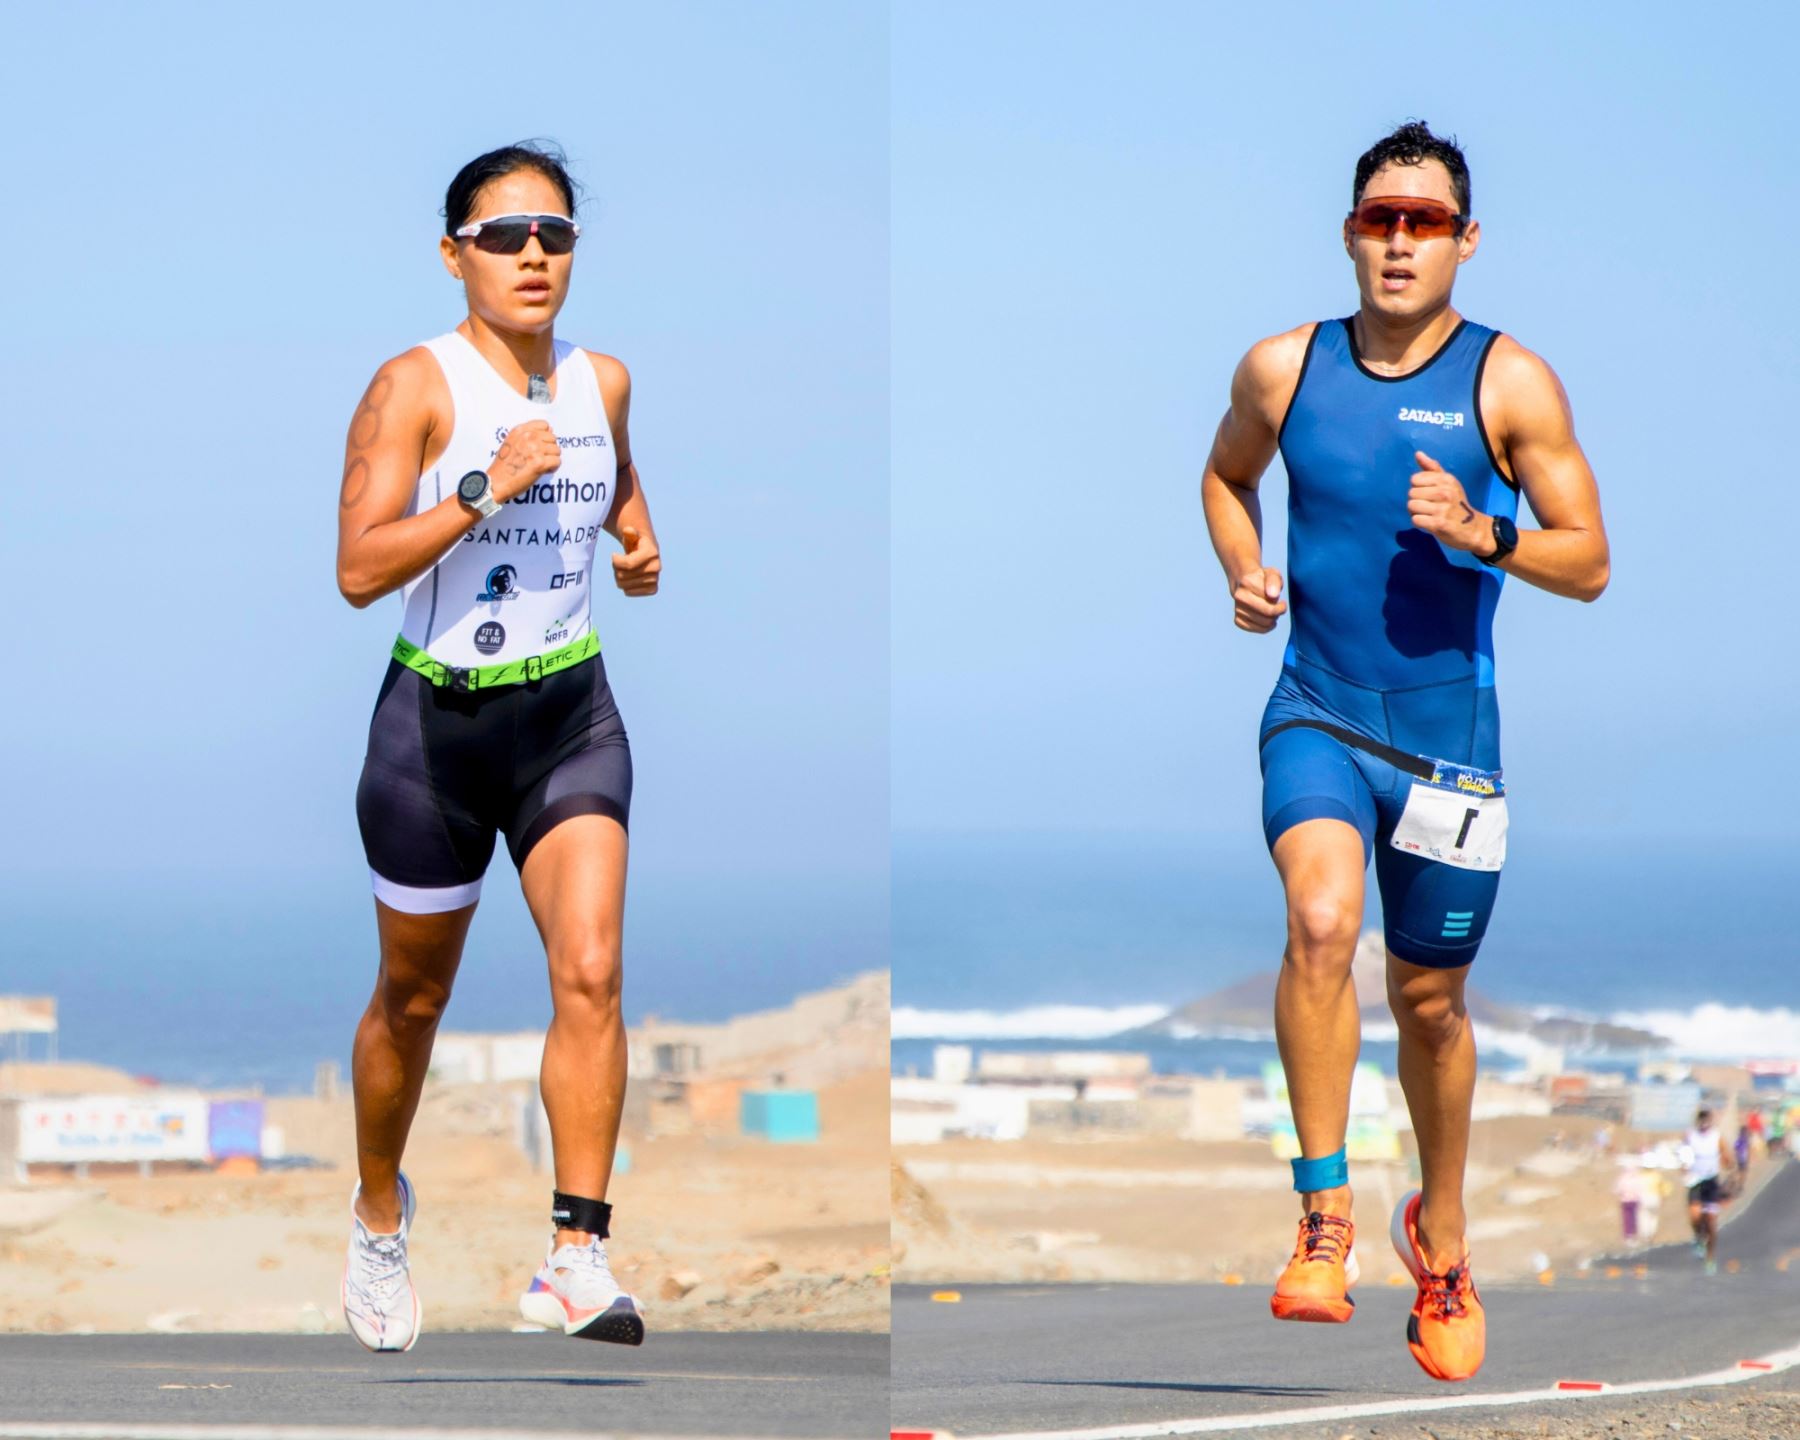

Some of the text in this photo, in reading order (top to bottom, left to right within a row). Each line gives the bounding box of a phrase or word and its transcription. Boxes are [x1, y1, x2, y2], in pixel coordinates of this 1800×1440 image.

[504, 478, 606, 504] arathon
[463, 524, 601, 546] SANTAMADRE
[478, 635, 501, 644] NO FAT
[544, 629, 569, 645] NRFB
